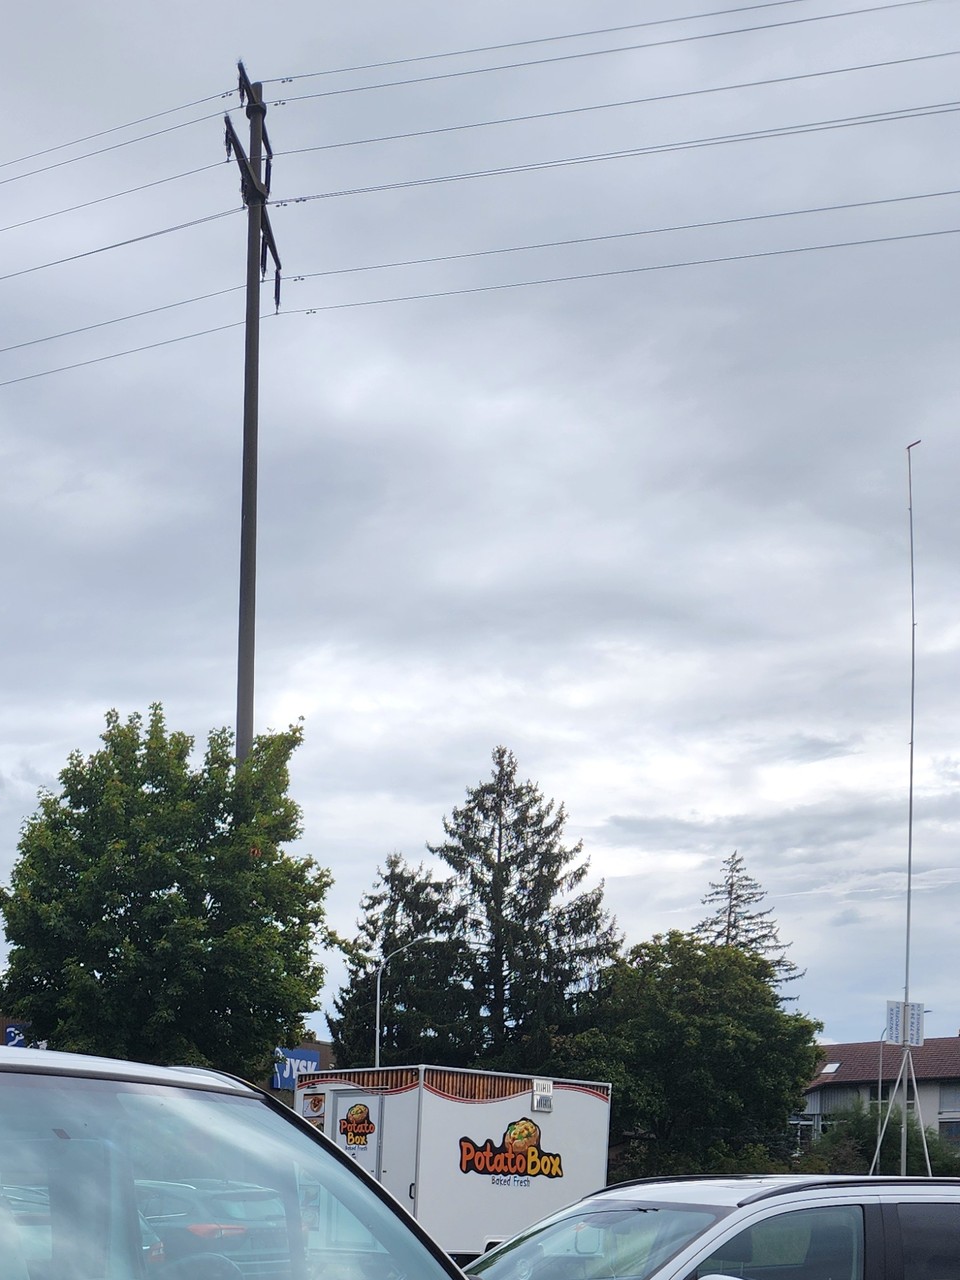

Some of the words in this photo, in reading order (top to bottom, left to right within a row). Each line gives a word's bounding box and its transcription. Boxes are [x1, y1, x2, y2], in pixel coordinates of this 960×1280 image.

[283, 1058, 318, 1079] JYSK
[340, 1119, 375, 1134] Potato
[347, 1132, 367, 1145] Box
[491, 1175, 511, 1187] Baked
[513, 1175, 531, 1187] Fresh
